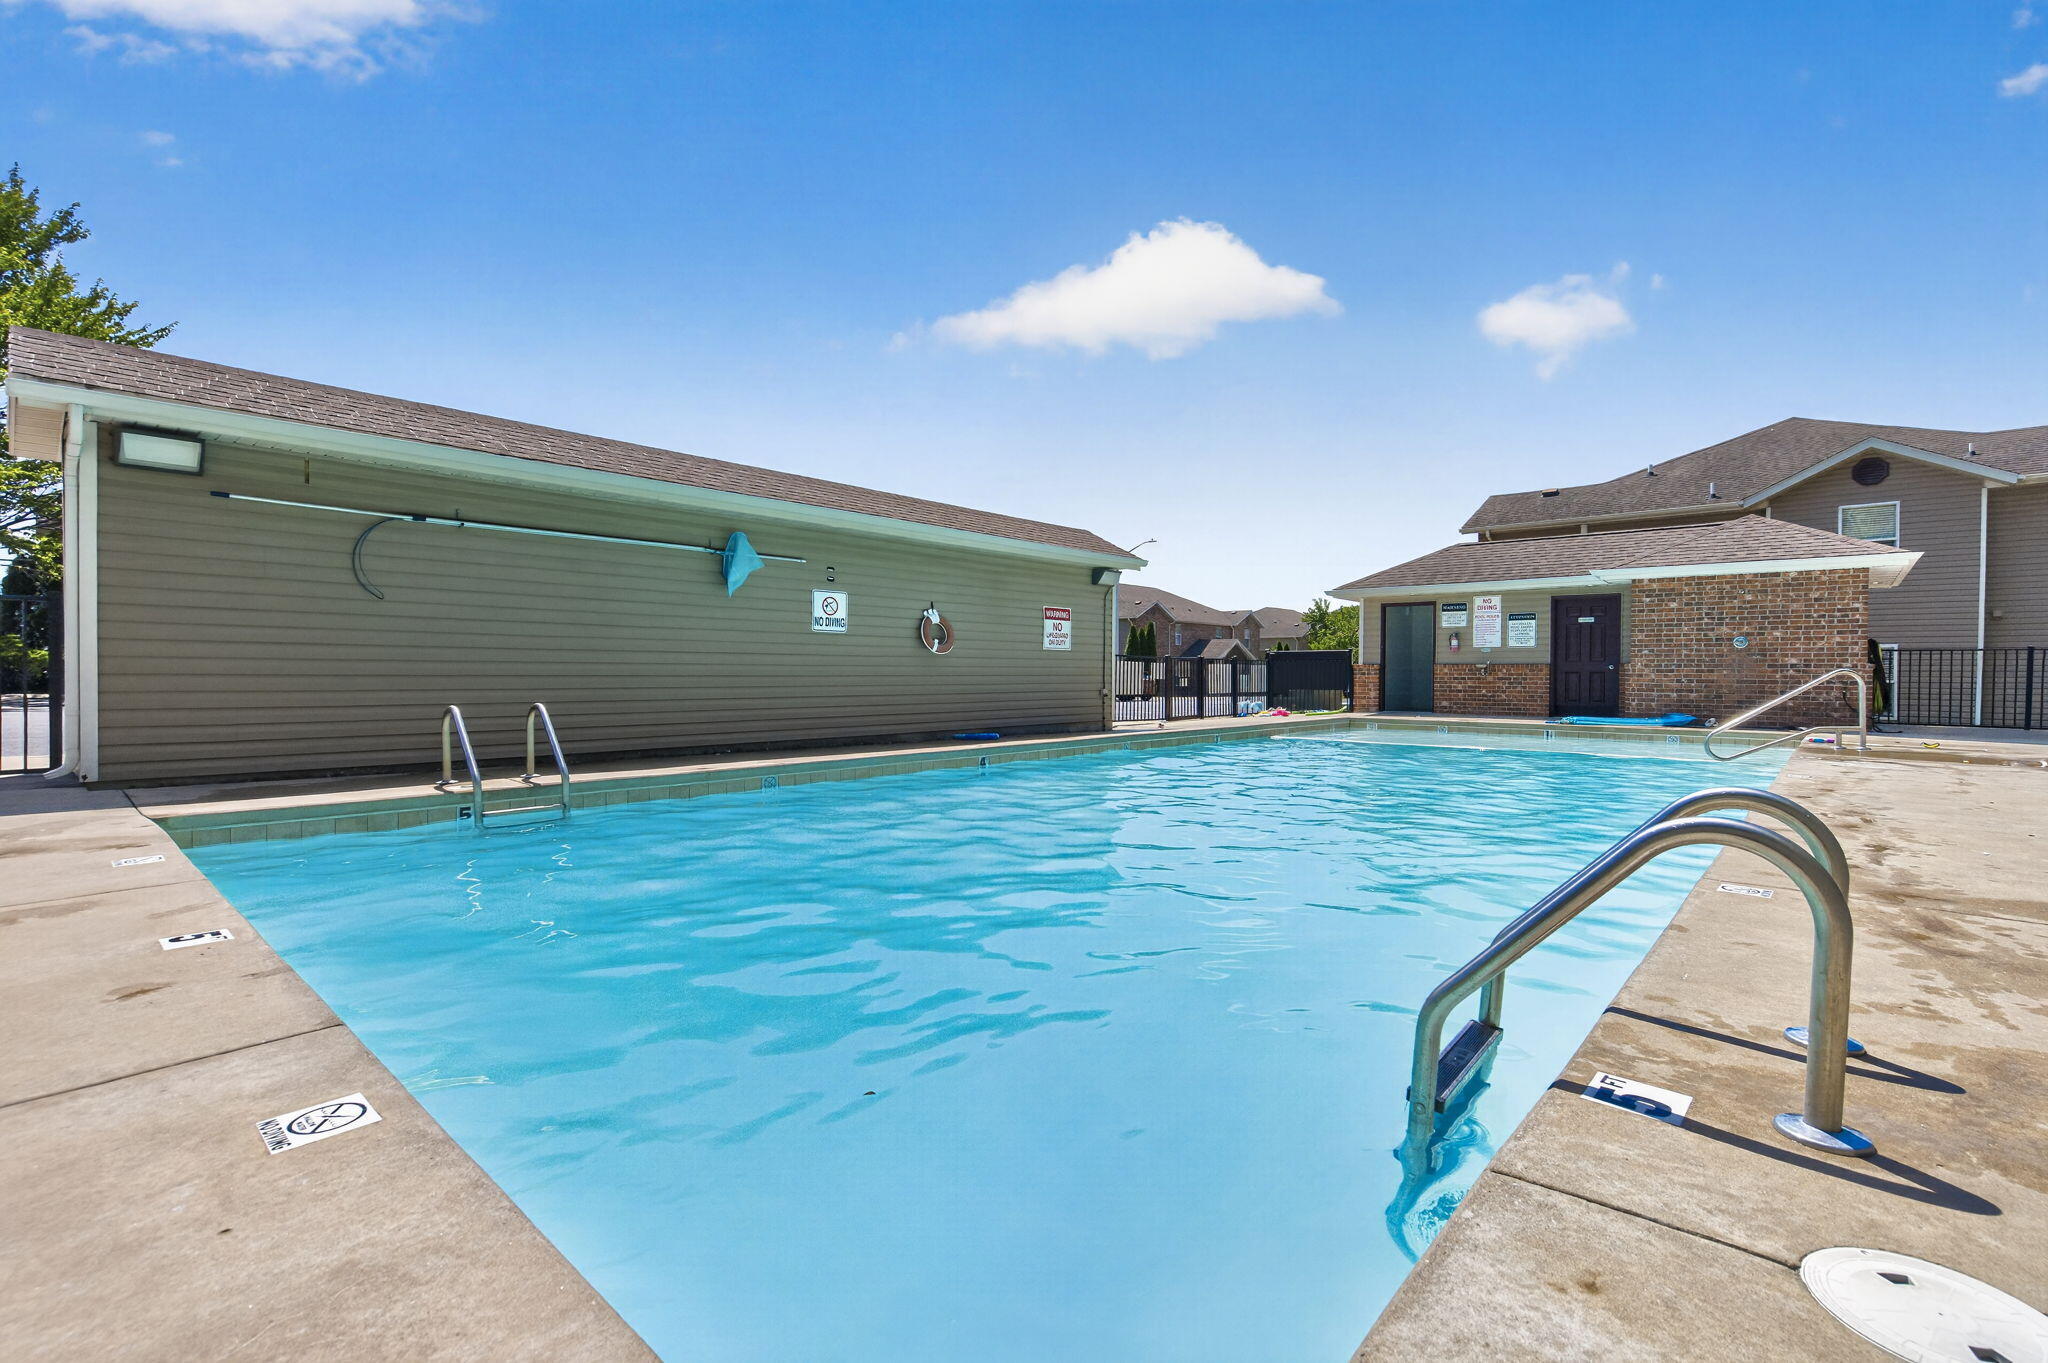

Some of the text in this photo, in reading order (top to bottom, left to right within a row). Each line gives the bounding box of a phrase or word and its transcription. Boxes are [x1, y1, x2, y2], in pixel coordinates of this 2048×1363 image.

[1045, 610, 1070, 619] WARNING
[814, 616, 846, 628] NO DIVING
[1052, 622, 1063, 632] NO
[459, 806, 472, 820] 5
[168, 930, 222, 943] 5
[1595, 1074, 1673, 1117] 5 FT
[259, 1118, 291, 1151] NO DIVING
